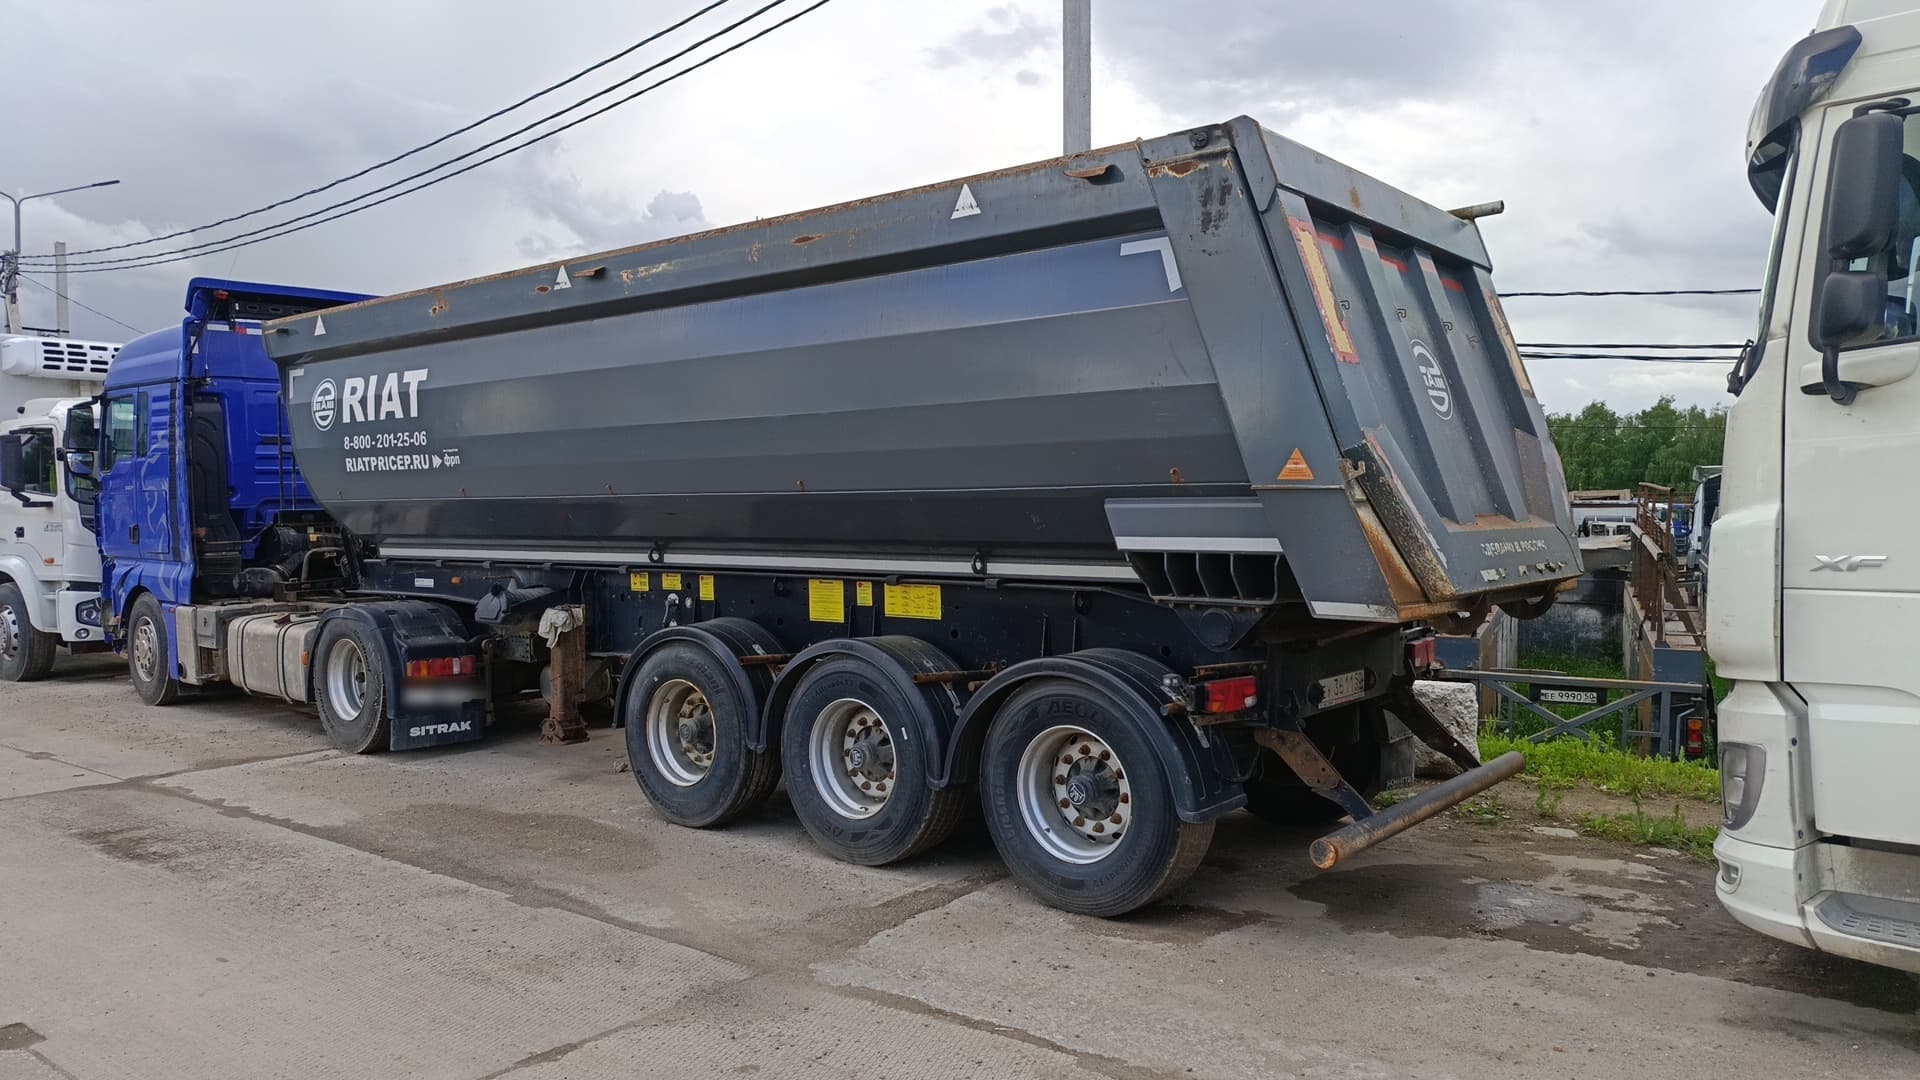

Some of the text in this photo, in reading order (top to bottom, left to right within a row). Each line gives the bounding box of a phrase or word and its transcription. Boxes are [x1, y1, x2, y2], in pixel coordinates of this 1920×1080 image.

[342, 368, 428, 423] RIAT
[345, 454, 429, 472] RIATPRICEP.RU
[1809, 554, 1887, 572] XF
[409, 721, 471, 737] SITRAK
